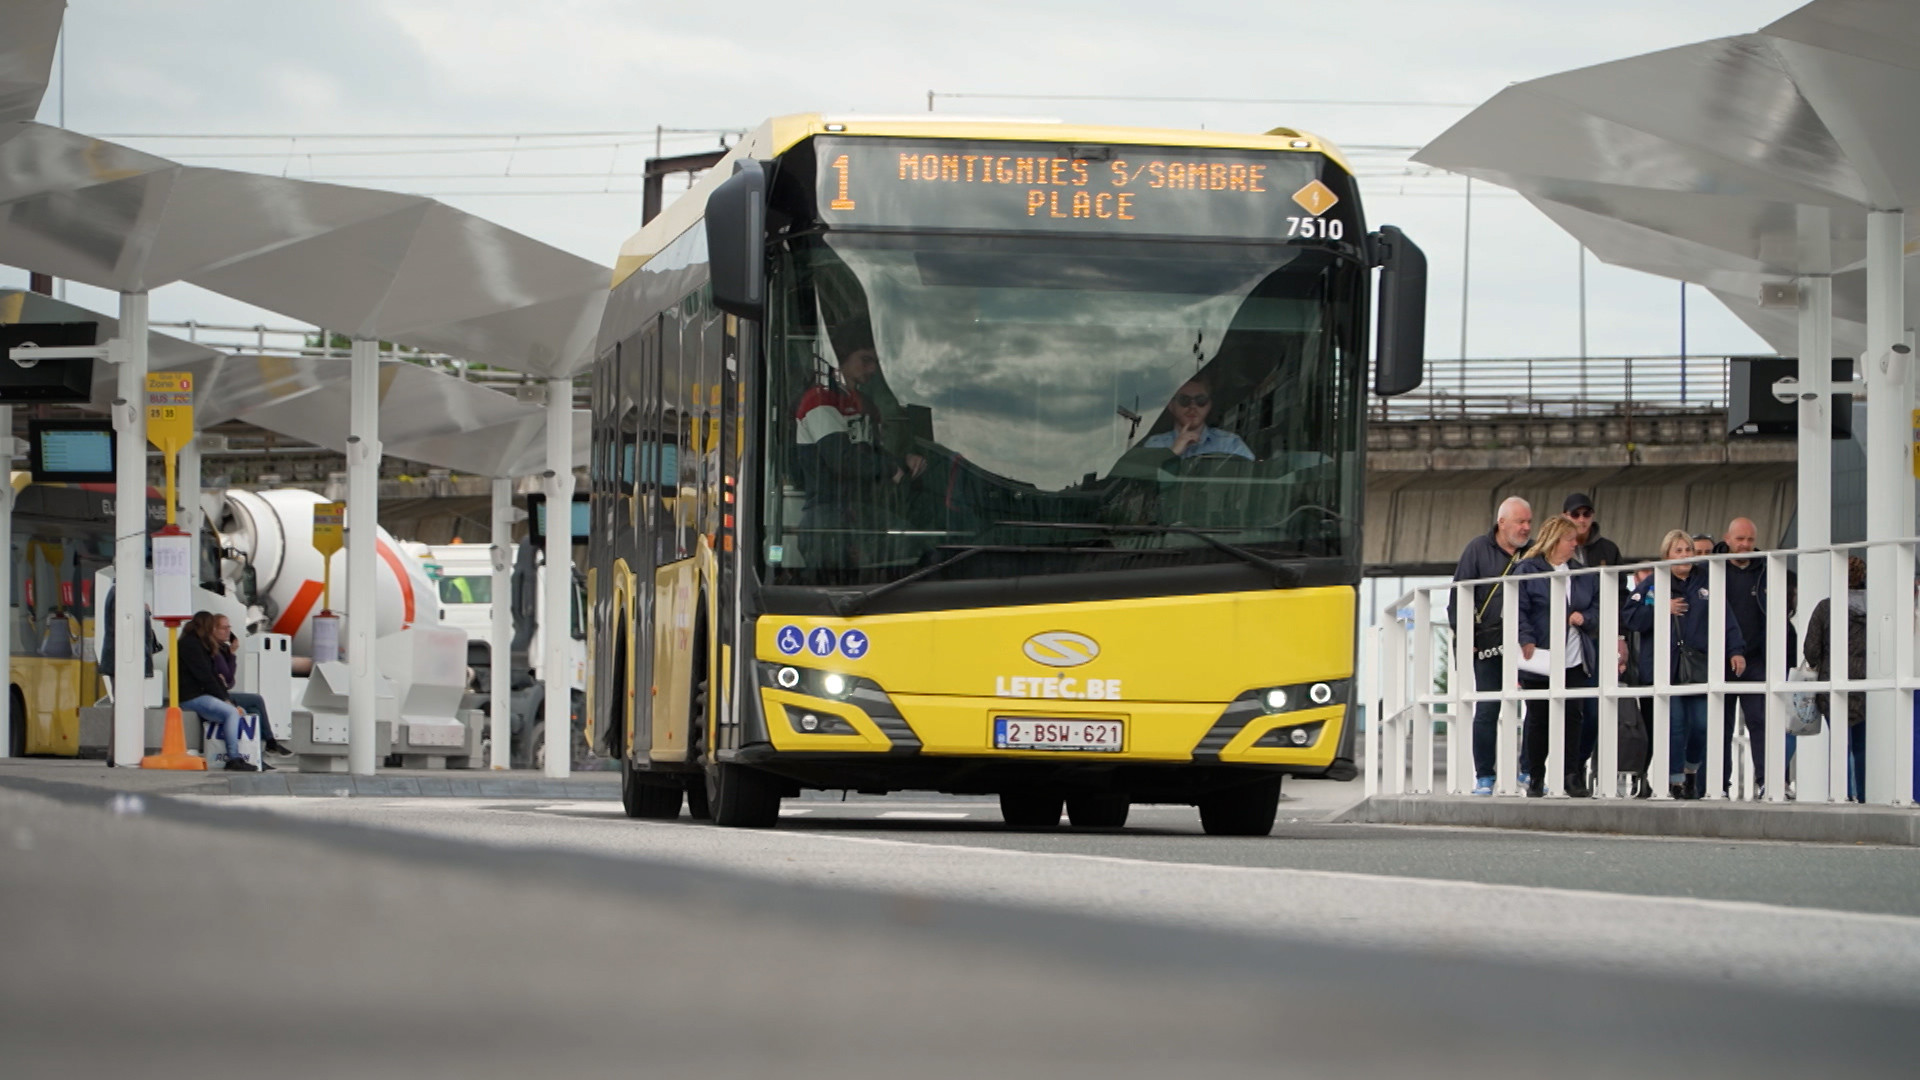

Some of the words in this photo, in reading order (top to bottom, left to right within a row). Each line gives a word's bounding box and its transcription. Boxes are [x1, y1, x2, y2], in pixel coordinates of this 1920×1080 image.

[830, 154, 856, 211] 1
[898, 152, 1089, 187] MONTIGNIES
[1110, 159, 1267, 193] S/SAMBRE
[1026, 188, 1136, 221] PLACE
[1286, 216, 1344, 240] 7510
[149, 393, 168, 403] BUS
[996, 676, 1122, 700] LETEC.BE
